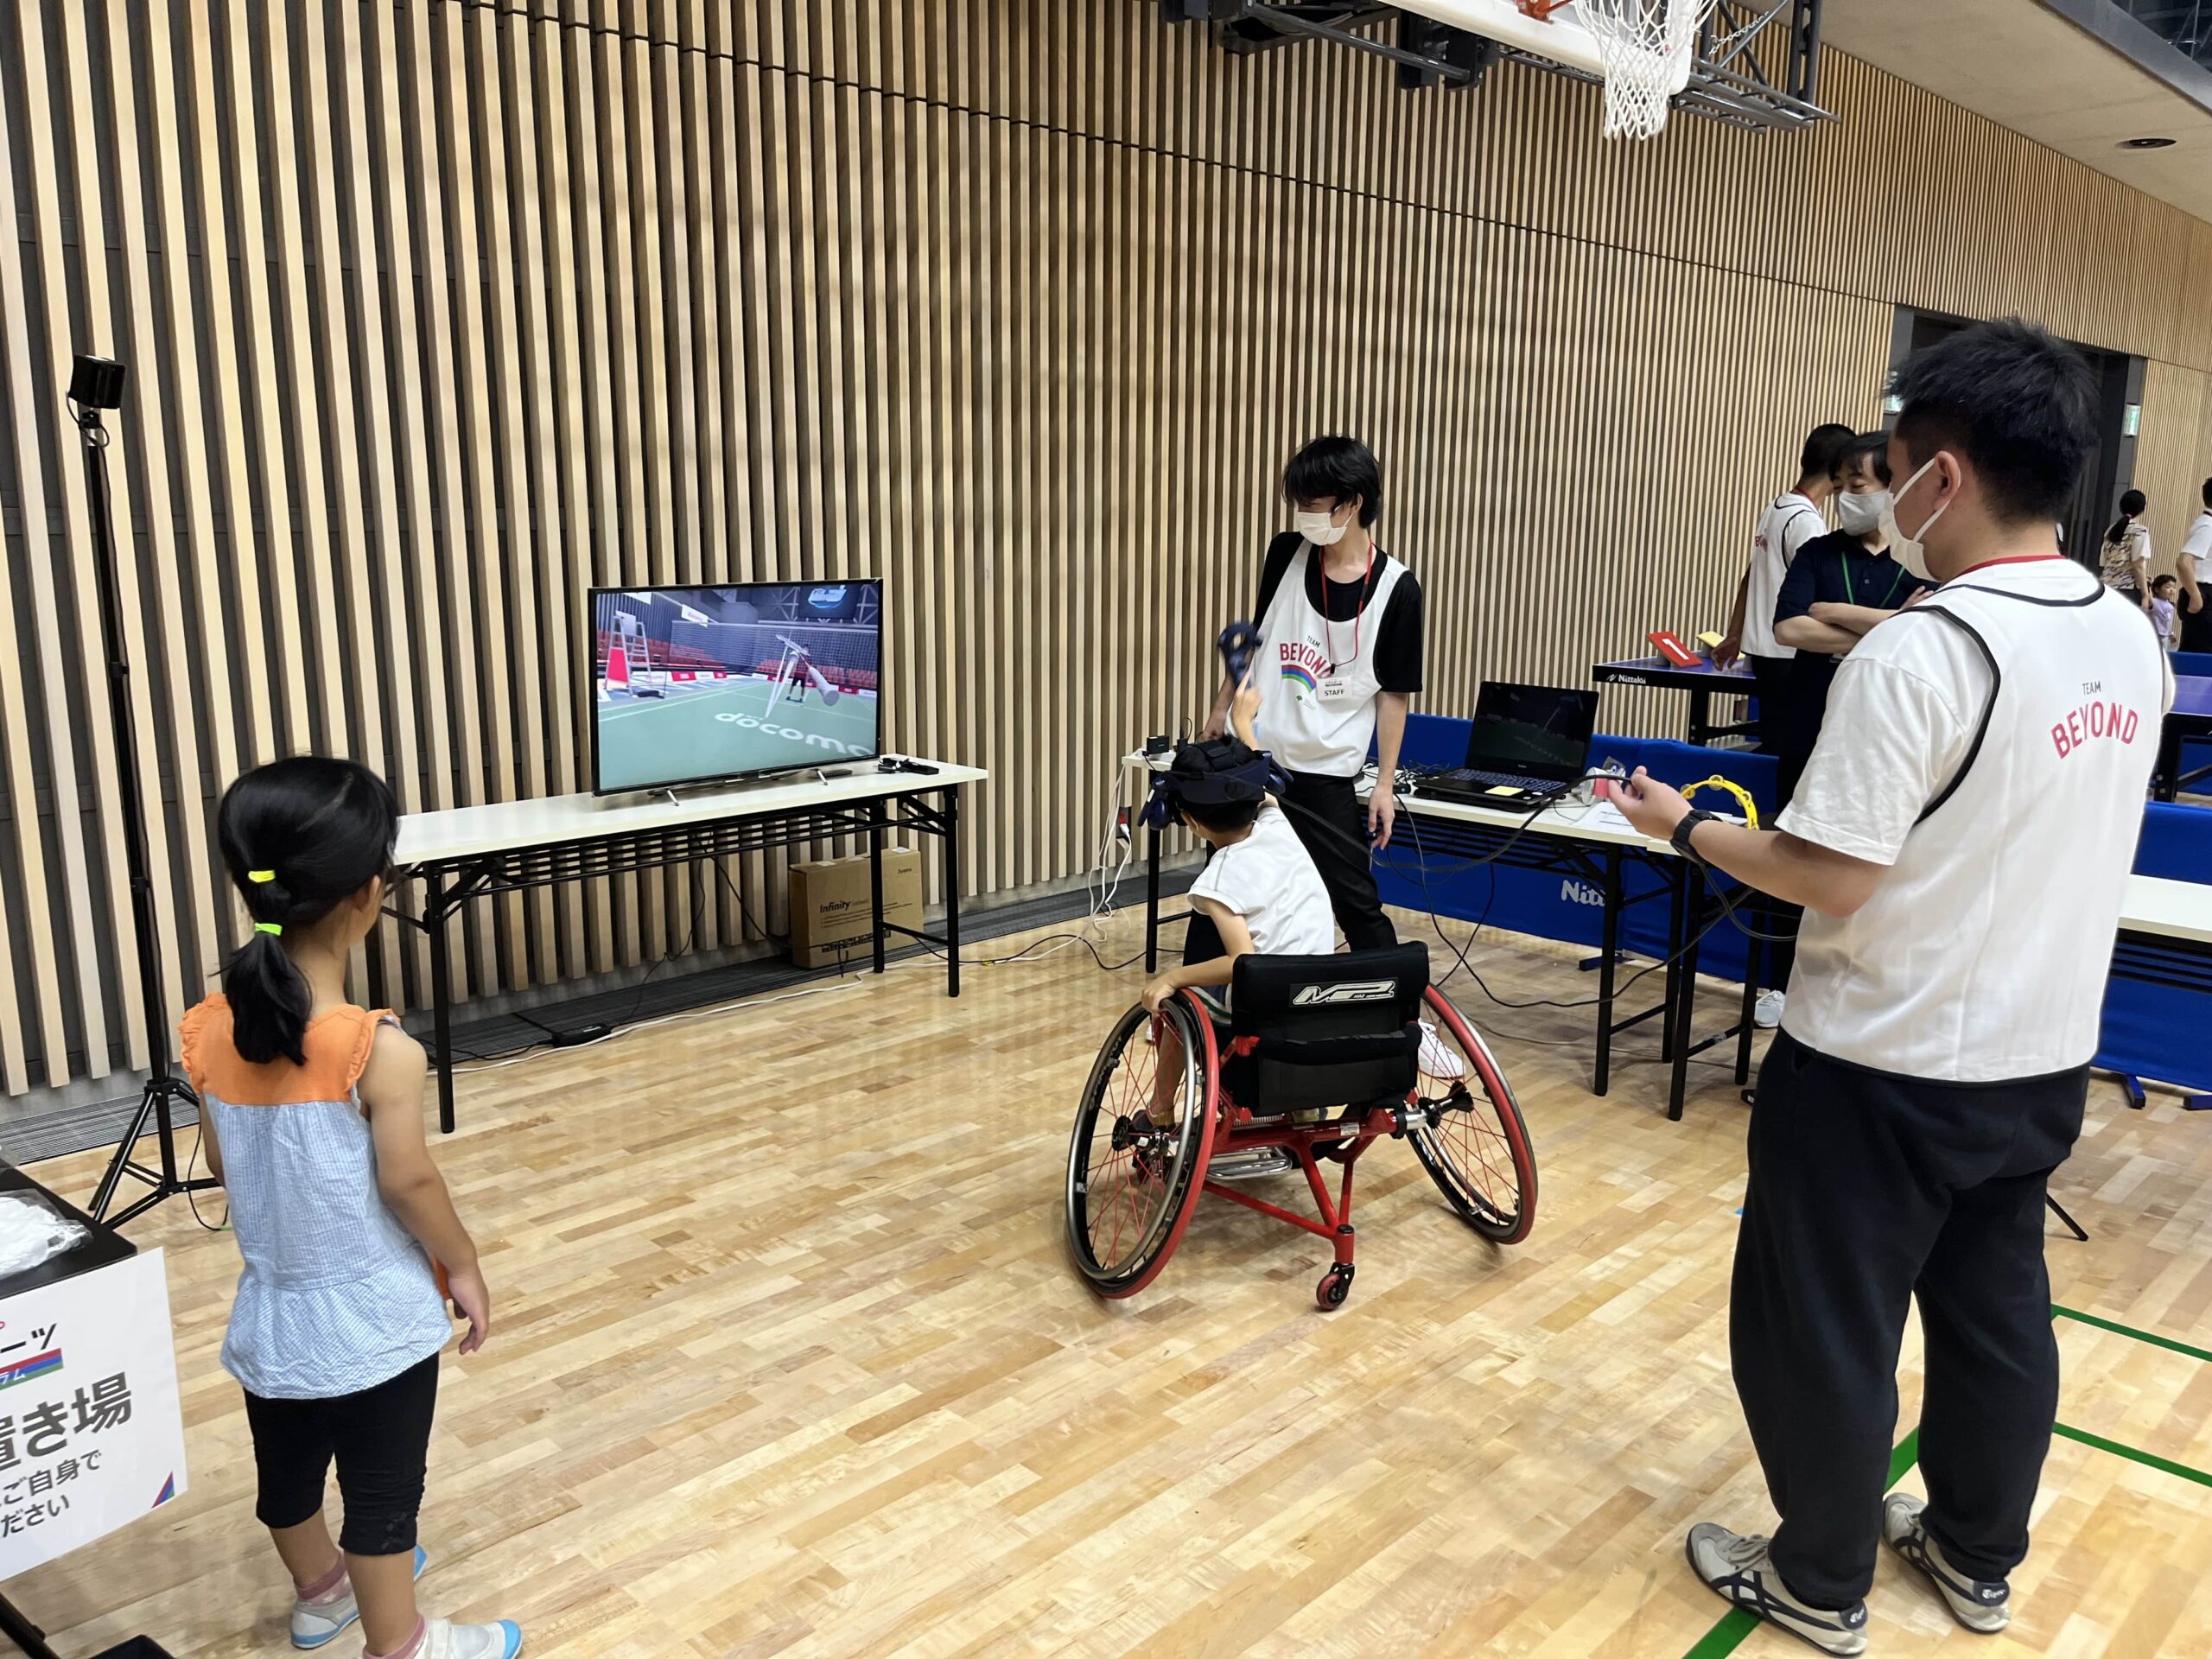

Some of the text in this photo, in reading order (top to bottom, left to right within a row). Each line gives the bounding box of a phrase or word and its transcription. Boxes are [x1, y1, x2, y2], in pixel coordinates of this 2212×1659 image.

[1662, 639, 1690, 660] 1
[1618, 674, 1646, 683] Nittaku
[2082, 681, 2101, 695] TEAM
[2050, 701, 2139, 760] BEYOND
[820, 900, 850, 913] Infinity
